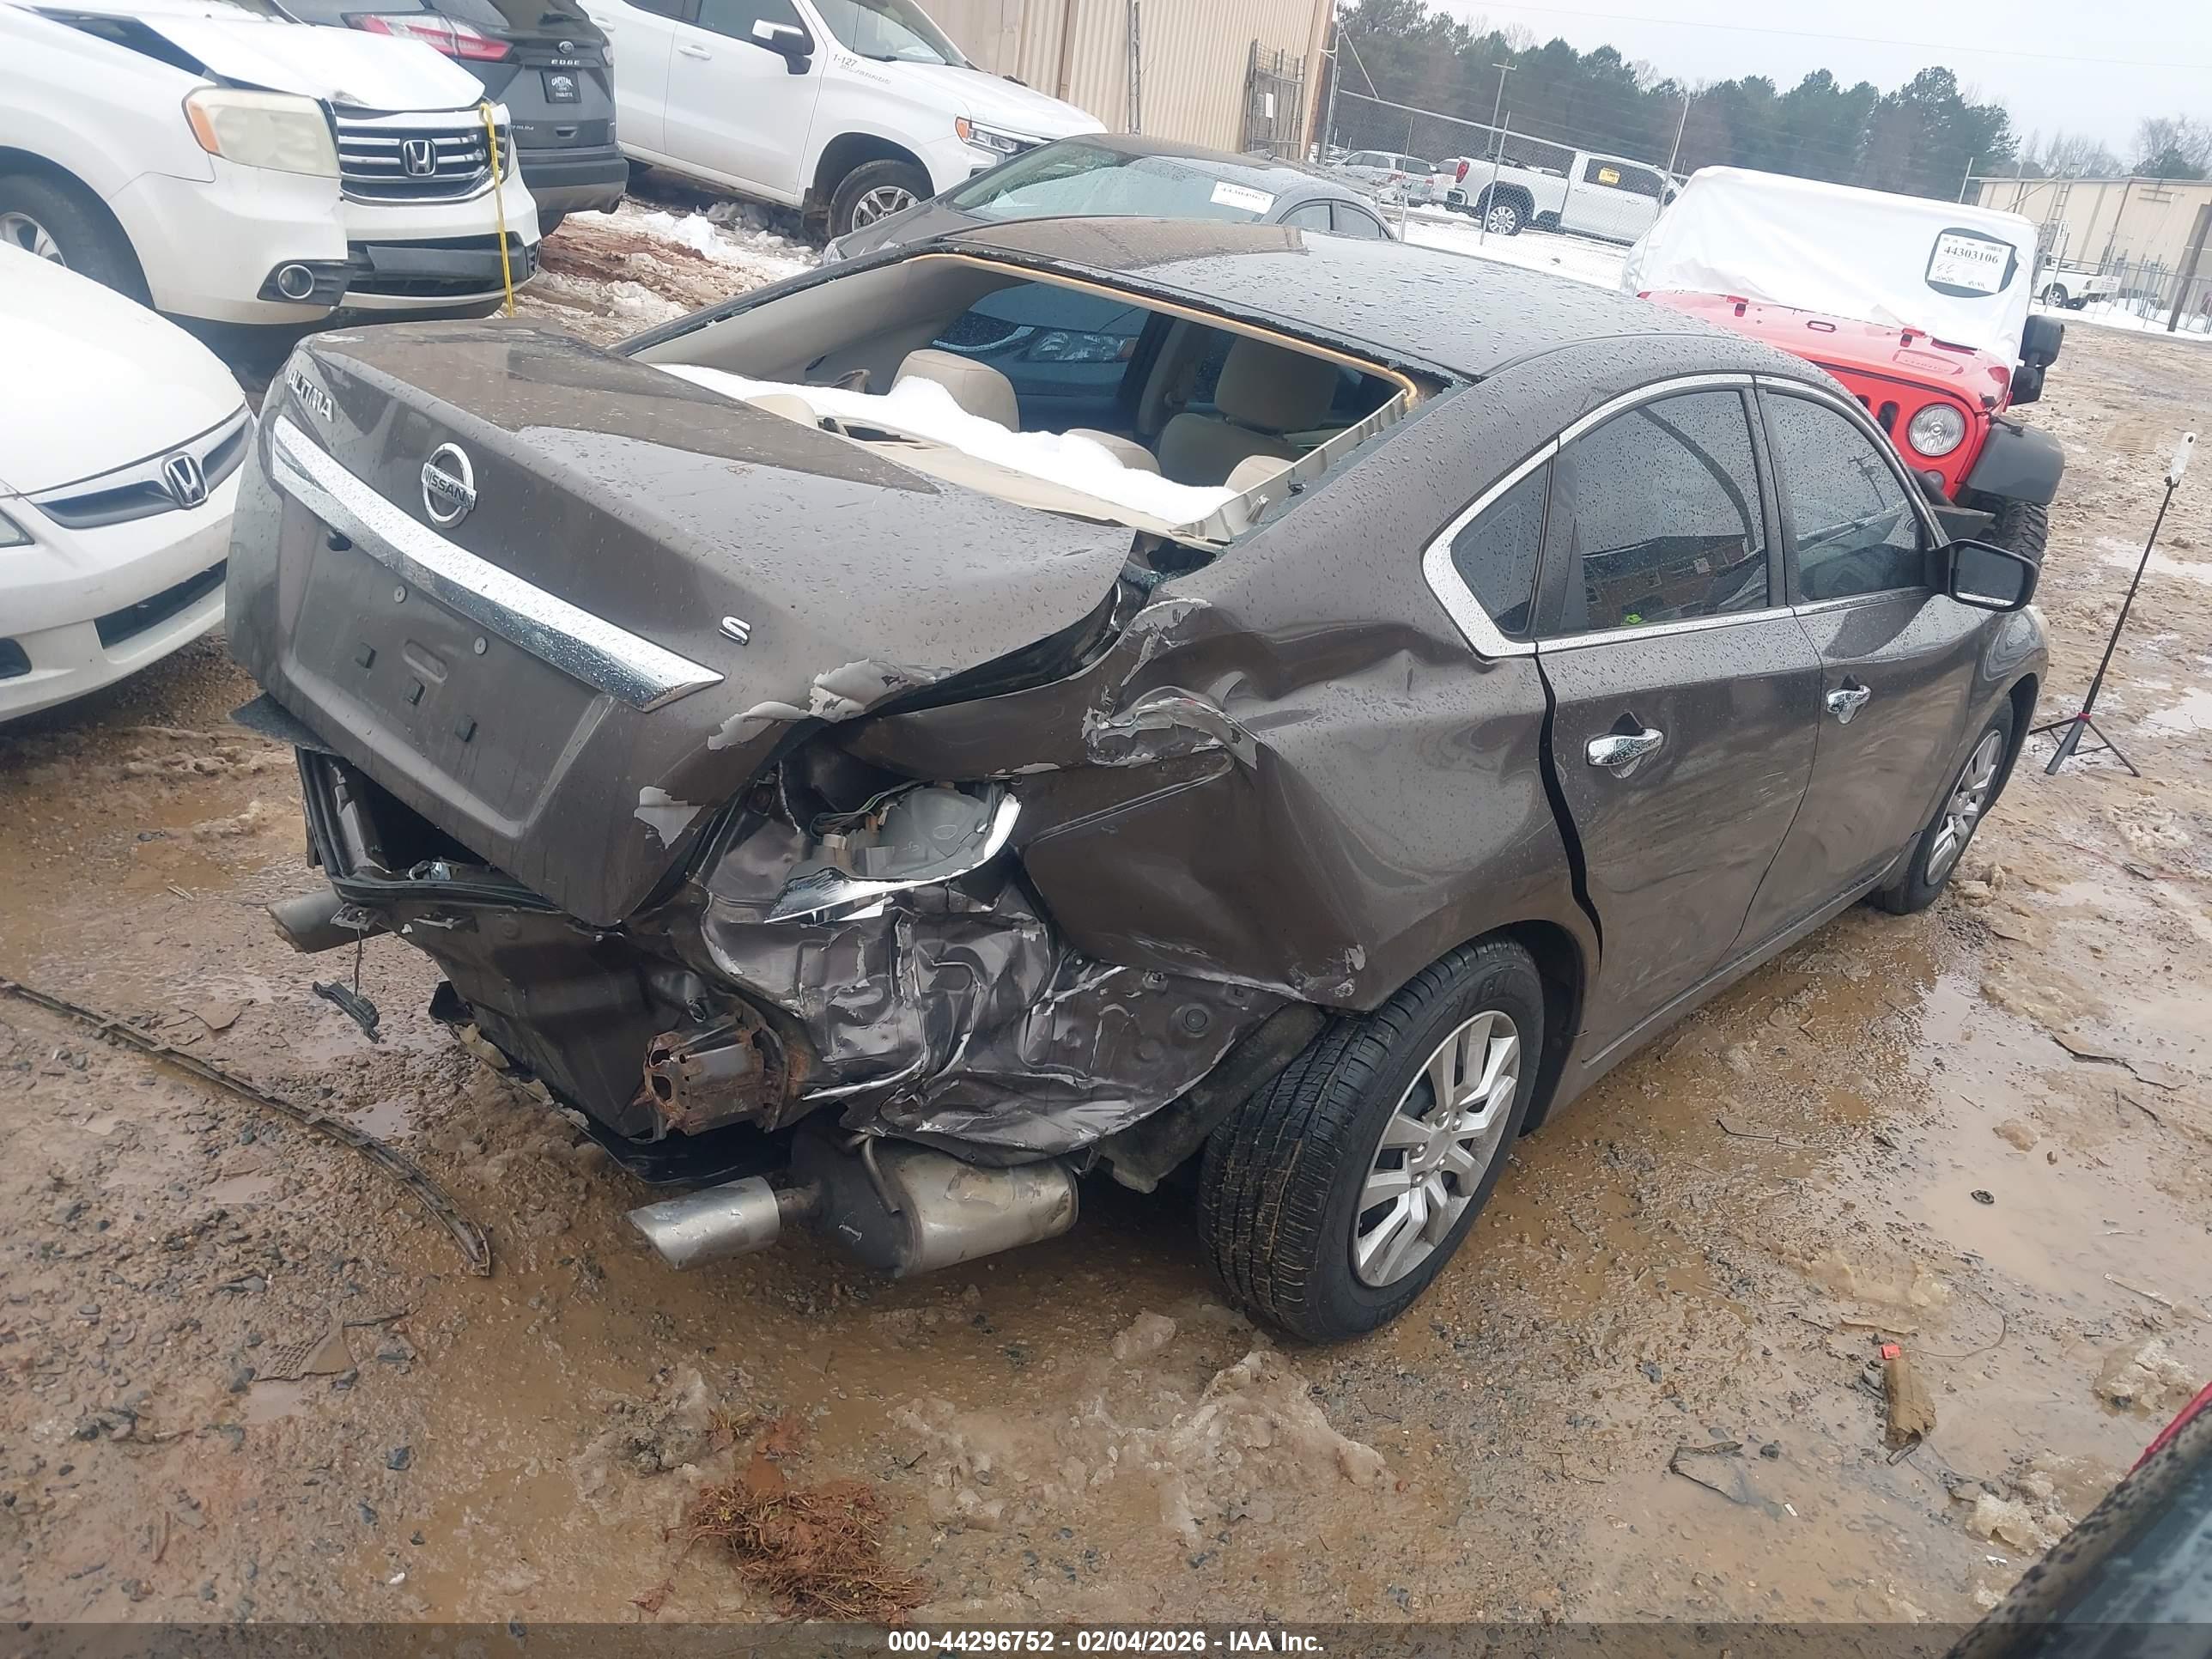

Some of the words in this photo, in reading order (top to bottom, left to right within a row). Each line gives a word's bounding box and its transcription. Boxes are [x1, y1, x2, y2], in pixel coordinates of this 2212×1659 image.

[551, 76, 574, 87] CAPITAL
[1944, 246, 1999, 264] 44303106
[288, 370, 335, 422] ALTIMA
[423, 469, 466, 502] NISSAN
[719, 615, 751, 646] S
